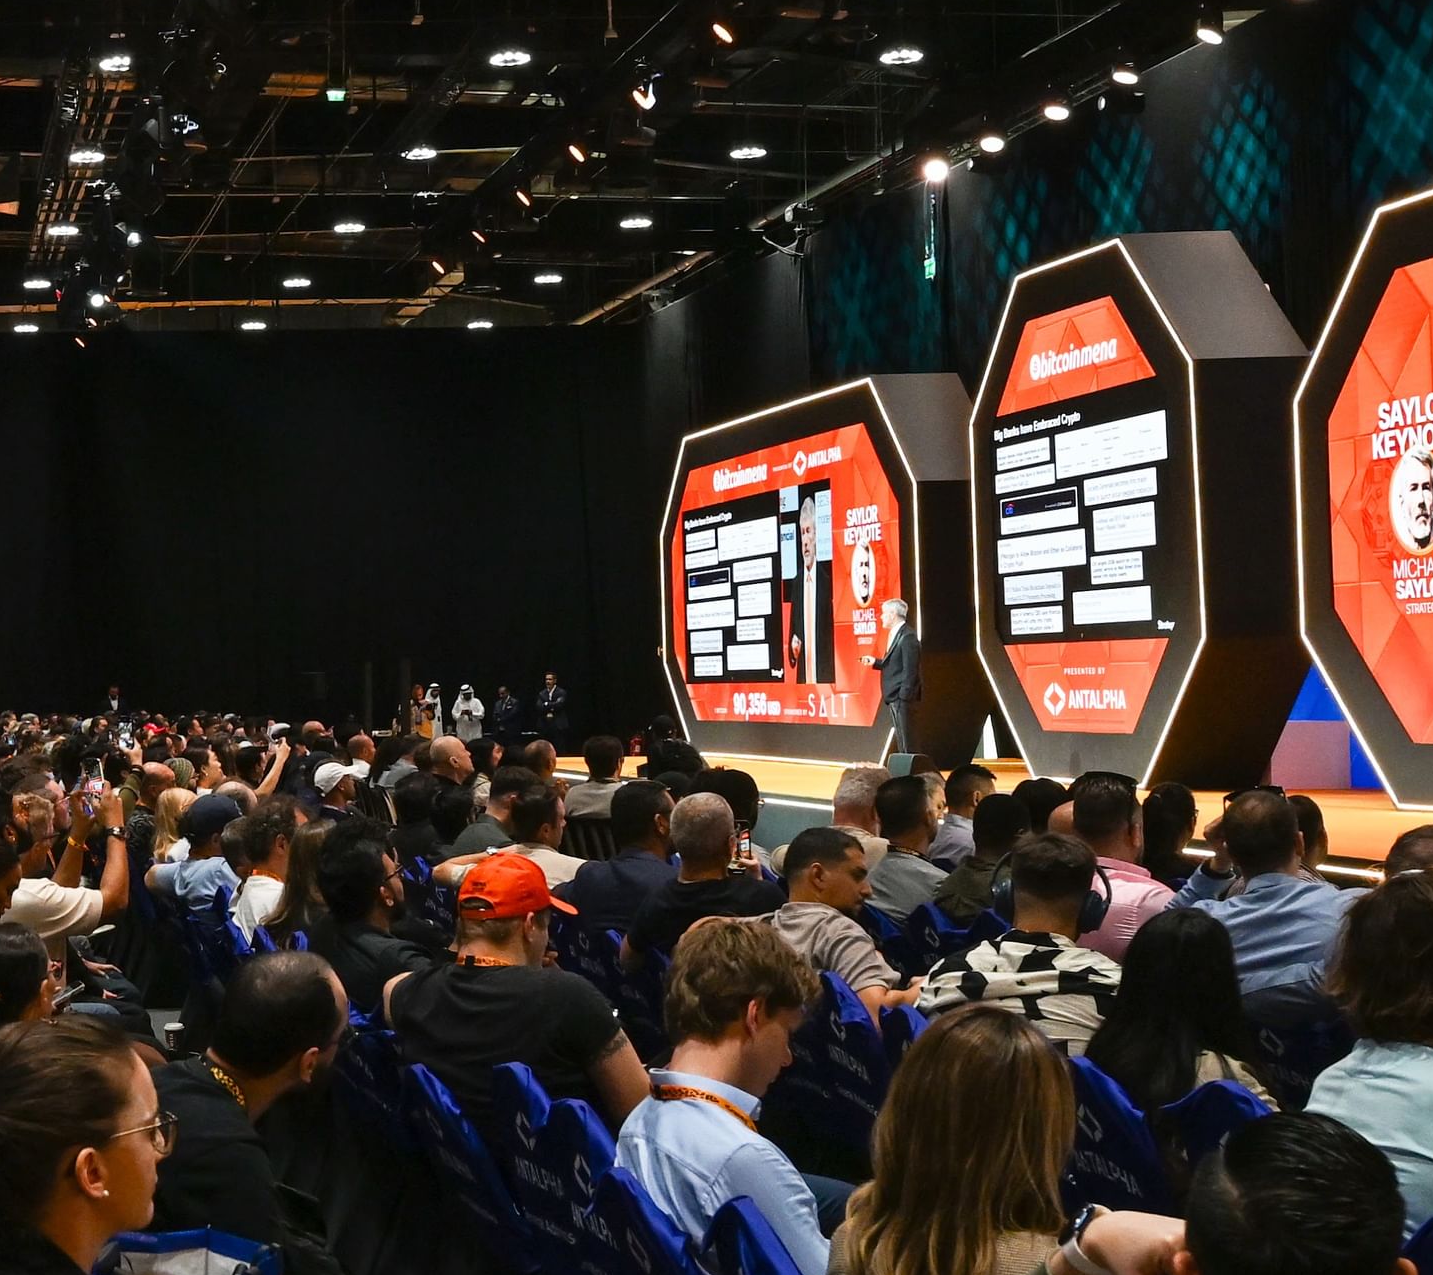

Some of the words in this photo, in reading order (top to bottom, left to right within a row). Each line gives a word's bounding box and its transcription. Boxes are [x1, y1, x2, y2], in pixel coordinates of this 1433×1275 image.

[1040, 338, 1118, 376] bitcoinmena
[807, 446, 843, 470] ANTALPHA
[721, 464, 767, 490] bitcoinmena
[846, 505, 878, 526] SAYLOR
[843, 524, 881, 546] KEYNOTE
[852, 608, 877, 622] MICHAEL
[853, 622, 877, 635] SAYLOR
[1063, 667, 1097, 676] PRESENTED
[1097, 667, 1105, 675] BY
[733, 692, 767, 721] 90,356
[767, 700, 781, 716] USD
[1068, 688, 1127, 710] ANTALPHA
